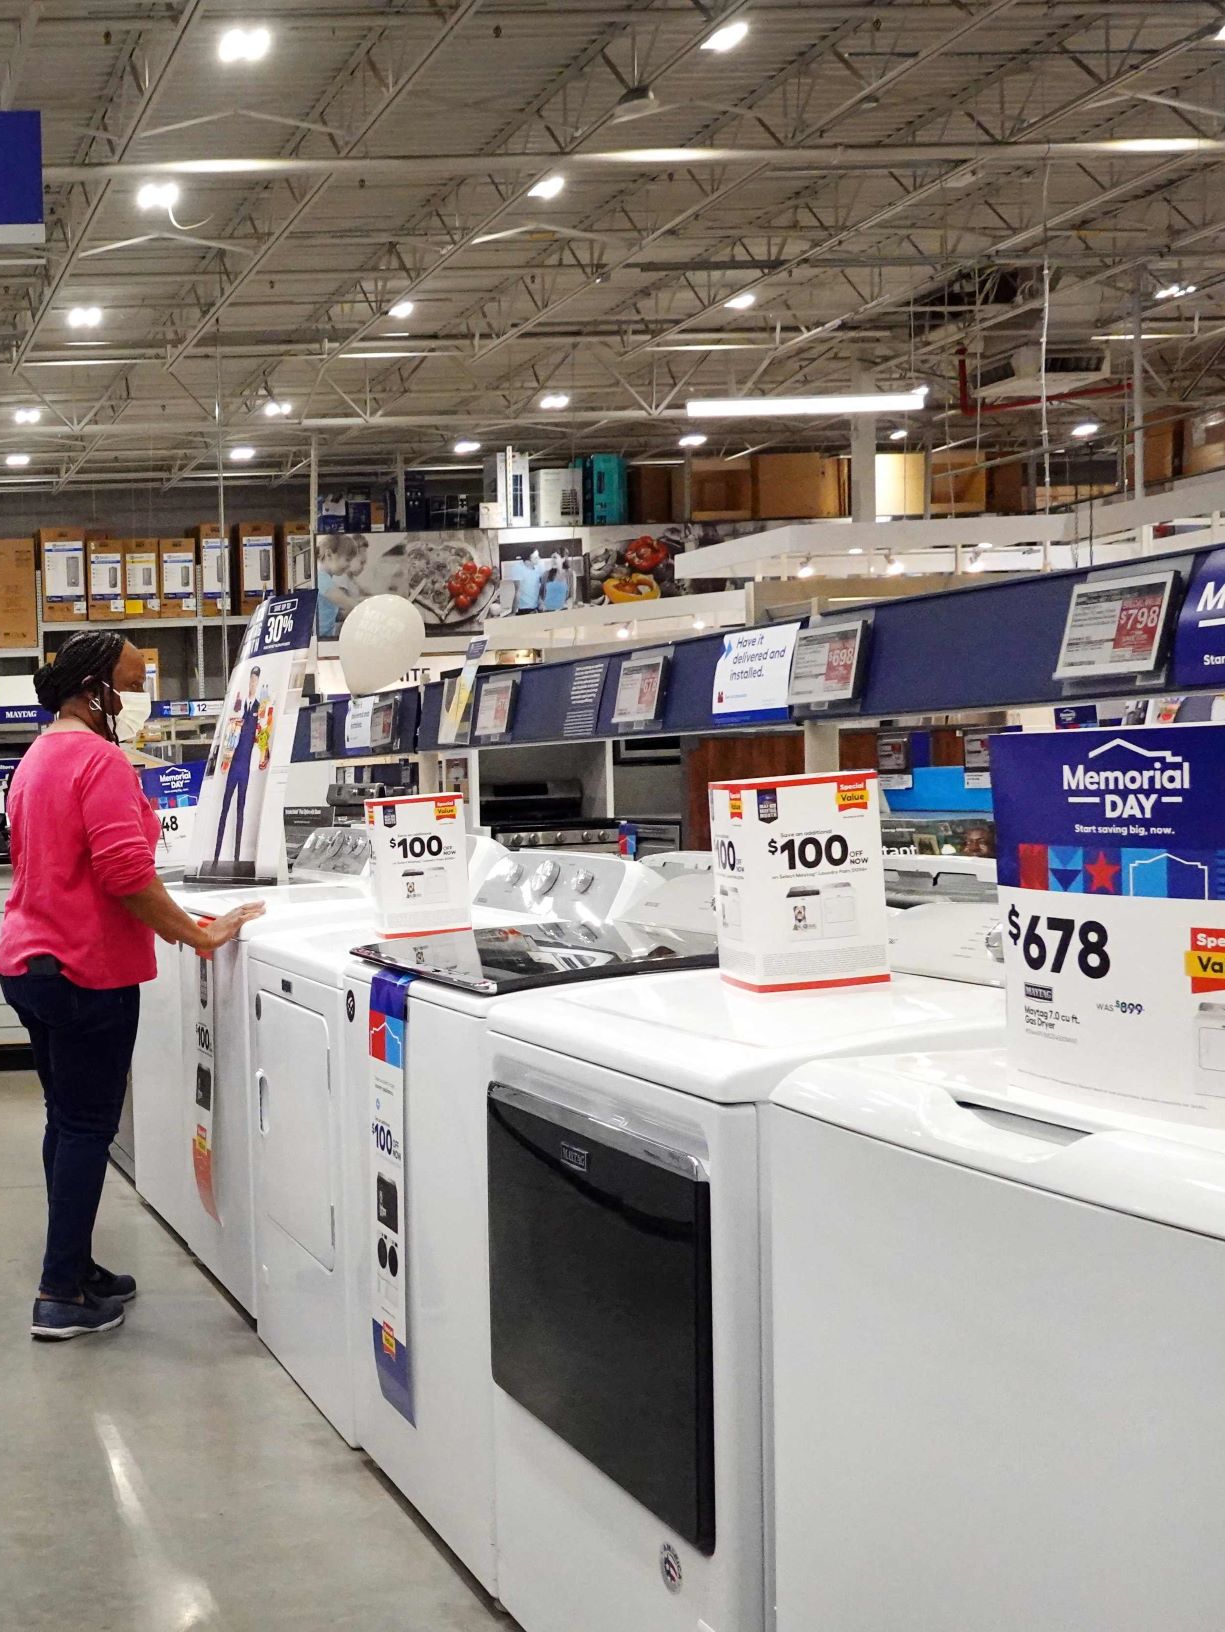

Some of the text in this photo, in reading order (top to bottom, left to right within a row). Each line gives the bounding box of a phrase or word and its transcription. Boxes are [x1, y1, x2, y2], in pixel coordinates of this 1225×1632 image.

[1196, 581, 1225, 612] M
[1119, 606, 1160, 630] $798
[264, 614, 294, 644] 30%
[736, 634, 764, 649] Have it
[732, 646, 786, 665] delivered and
[828, 649, 854, 667] $698
[1203, 654, 1225, 666] Star
[729, 666, 764, 682] installed.
[6, 710, 38, 718] MAYTAG
[196, 704, 207, 712] 12
[159, 769, 191, 782] Memorial
[1062, 762, 1190, 790] Memorial
[170, 780, 184, 788] DAY
[840, 782, 864, 790] Special
[840, 793, 864, 802] Value
[1104, 794, 1158, 818] DAY
[161, 816, 178, 832] 48
[1074, 824, 1176, 836] Start saving big, now.
[390, 835, 443, 858] $100
[768, 834, 849, 870] $100
[850, 850, 864, 858] OFF
[882, 844, 916, 855] tant
[850, 857, 868, 865] NOW
[1008, 904, 1110, 979] $678
[1196, 934, 1225, 948] Spe
[1198, 956, 1225, 974] Va
[1024, 986, 1053, 1000] MAYTAG
[1024, 1005, 1080, 1024] Maytag 7.0 cu ft.
[1096, 1000, 1145, 1016] WAS $899
[1025, 1015, 1055, 1030] Gas Dryer
[372, 1122, 392, 1156] $100
